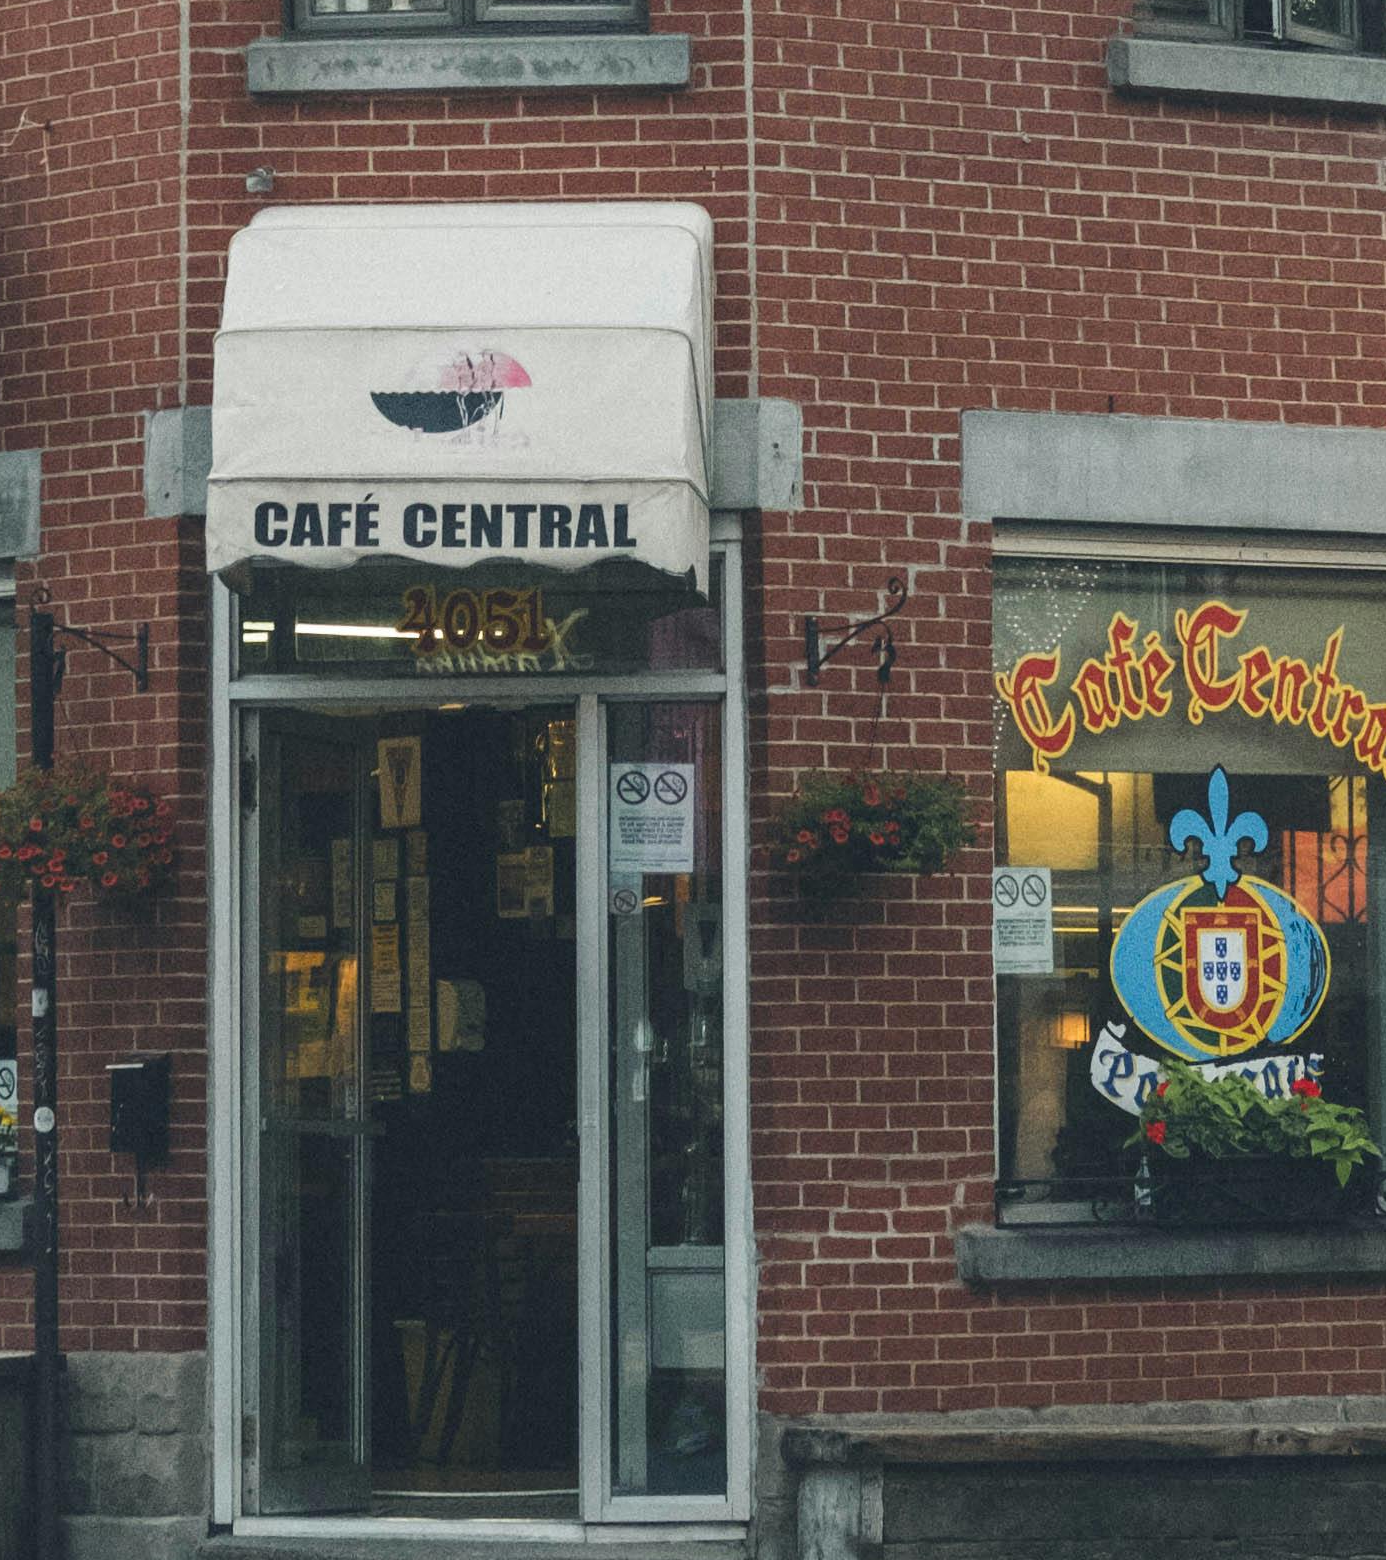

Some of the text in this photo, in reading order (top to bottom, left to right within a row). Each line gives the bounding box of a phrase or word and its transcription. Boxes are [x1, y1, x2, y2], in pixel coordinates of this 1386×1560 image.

[254, 492, 637, 549] CAFÉ CENTRAL
[395, 583, 552, 656] 4051
[995, 610, 1175, 777] Café
